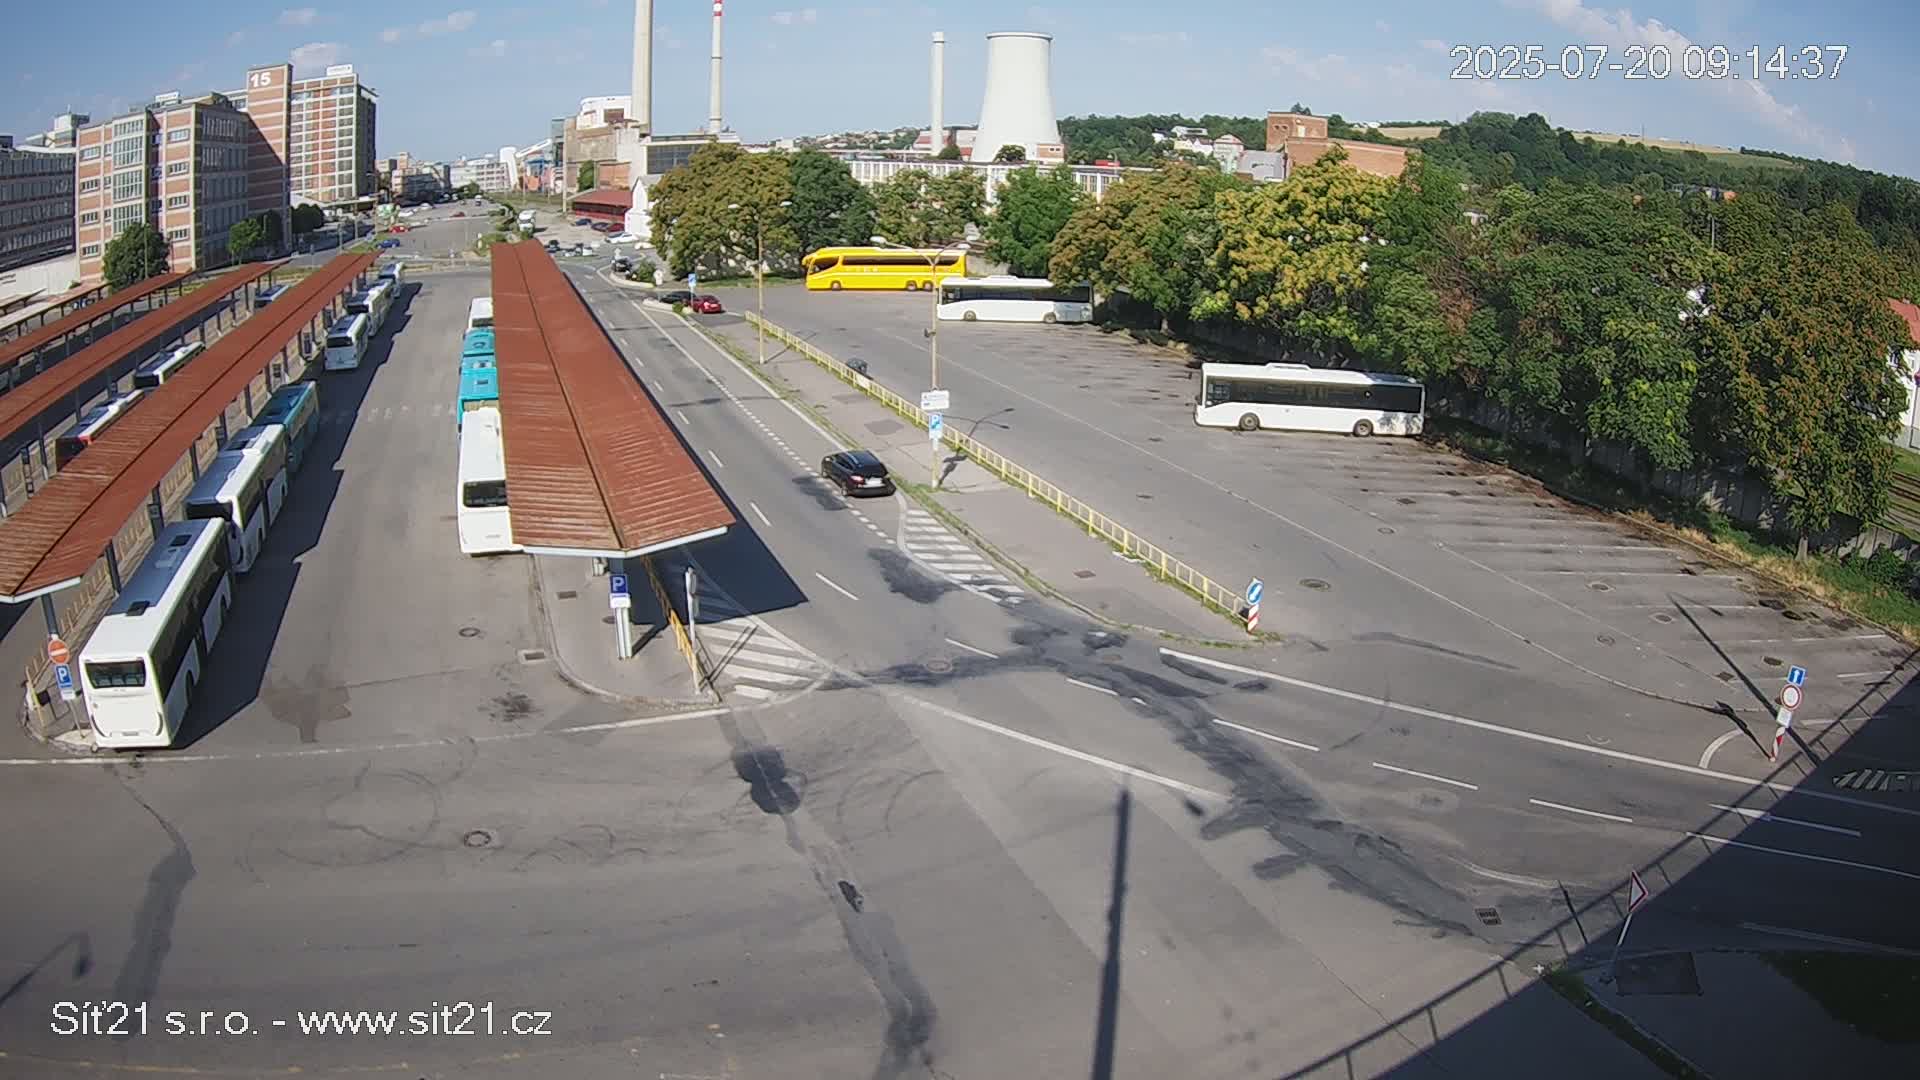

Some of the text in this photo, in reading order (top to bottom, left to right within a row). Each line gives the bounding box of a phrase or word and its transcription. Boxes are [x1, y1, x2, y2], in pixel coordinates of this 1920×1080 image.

[250, 72, 271, 88] 15
[612, 576, 625, 592] P
[58, 667, 67, 682] P
